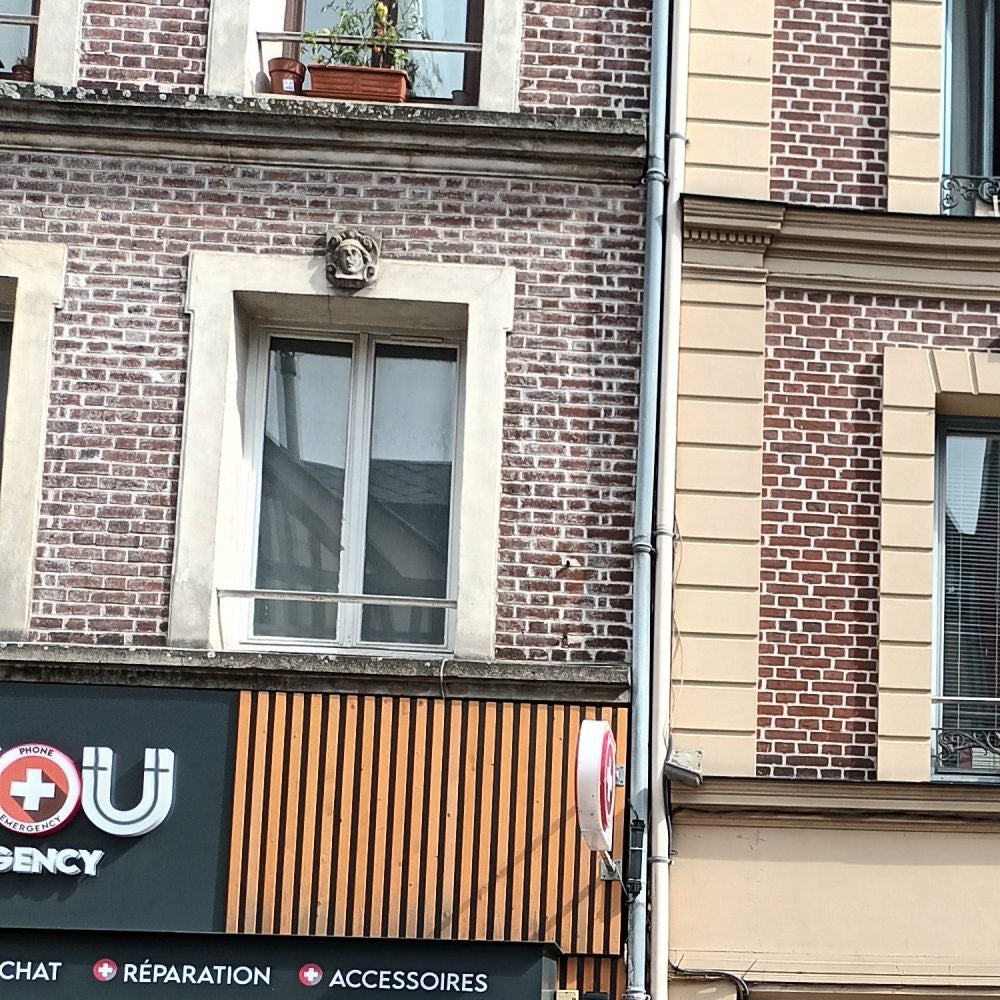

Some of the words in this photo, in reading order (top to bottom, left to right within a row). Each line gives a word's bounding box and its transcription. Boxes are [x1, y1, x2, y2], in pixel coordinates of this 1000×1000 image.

[19, 746, 55, 758] PHONE
[0, 812, 62, 833] EMERGENCY
[123, 959, 272, 986] RÉPARATION
[328, 968, 489, 993] ACCESSOIRES
